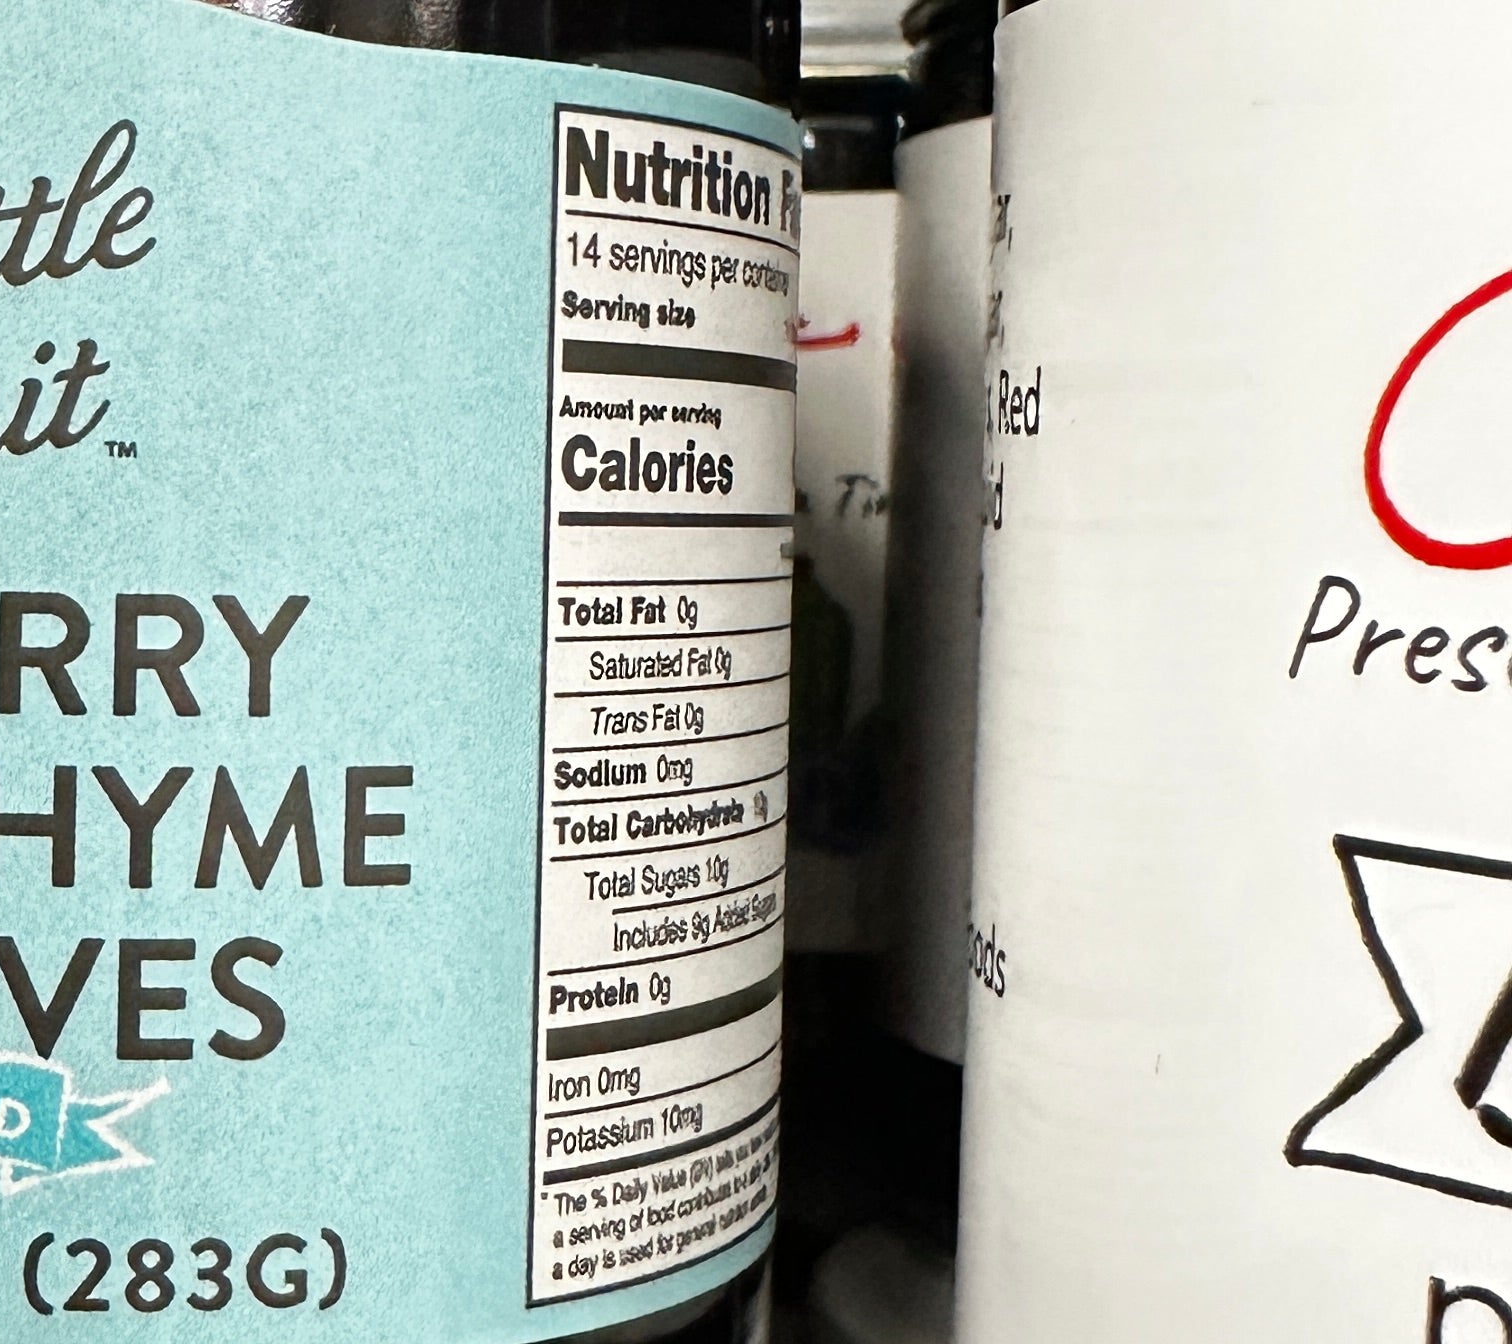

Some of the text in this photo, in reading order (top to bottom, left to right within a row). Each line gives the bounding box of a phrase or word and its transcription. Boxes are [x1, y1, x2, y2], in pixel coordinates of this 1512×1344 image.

[564, 127, 771, 225] Nutrition
[567, 231, 601, 269] 14
[608, 239, 707, 283] servings
[709, 250, 740, 289] per
[561, 290, 697, 330] Serving size
[558, 395, 723, 430] Amount per serving
[998, 366, 1042, 436] Red
[560, 434, 734, 495] Calories
[558, 593, 699, 630] Total Fat 0g
[1288, 575, 1512, 693] Pres
[589, 647, 732, 681] Saturated Fat 0g
[590, 701, 705, 736] Trans Fat 0g
[553, 754, 694, 789] Sodium 0mg
[553, 812, 619, 845] Total
[584, 854, 731, 901] Total Sugars 10g
[612, 910, 688, 953] Includes
[548, 971, 672, 1014] Protein 0g
[547, 1065, 642, 1102] Iron 0mg
[545, 1100, 704, 1159] Potassium 10mg
[553, 1192, 589, 1217] The
[552, 1229, 565, 1249] a
[568, 1216, 627, 1246] serving
[22, 1227, 349, 1316] (283G)
[551, 1261, 564, 1281] a
[567, 1252, 600, 1280] day
[602, 1247, 617, 1269] is
